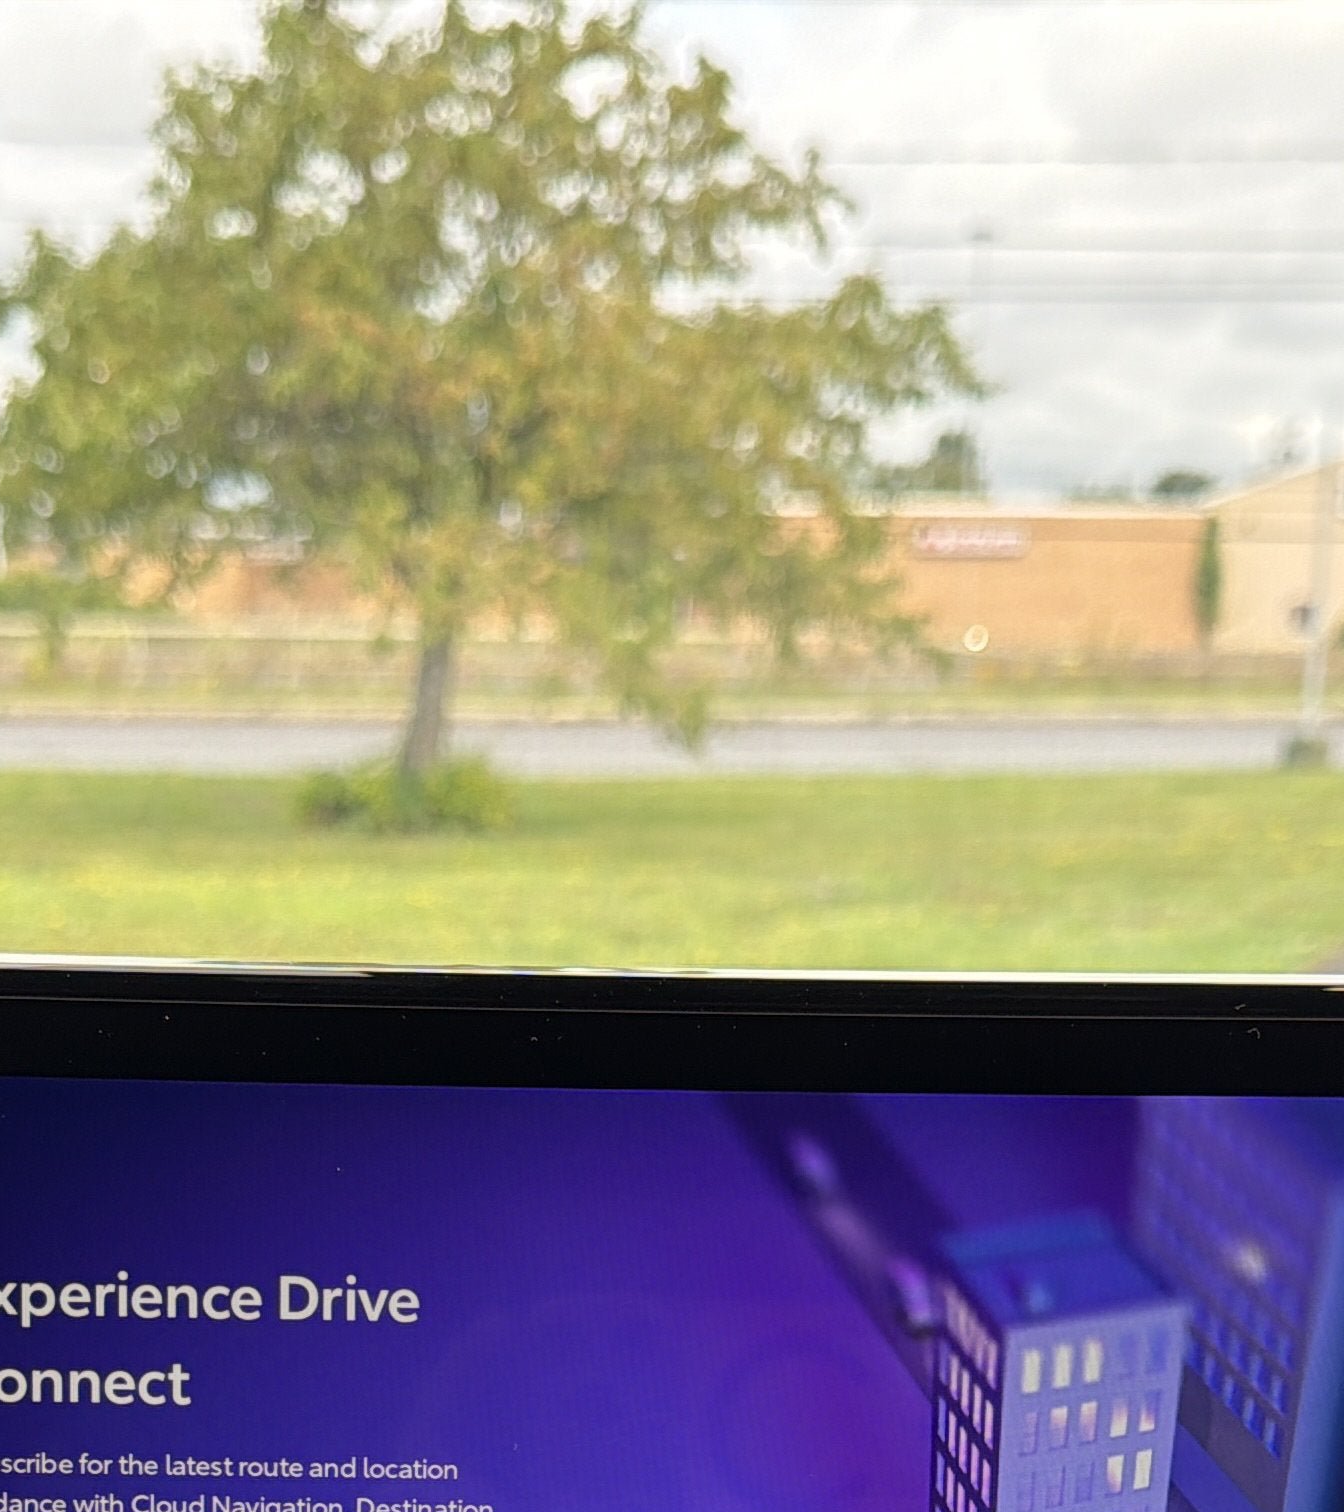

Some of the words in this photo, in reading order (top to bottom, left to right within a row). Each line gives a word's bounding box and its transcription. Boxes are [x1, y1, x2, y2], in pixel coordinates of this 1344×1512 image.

[279, 1275, 420, 1323] Drive
[79, 1452, 112, 1475] for
[118, 1452, 158, 1476] the
[164, 1454, 234, 1477] latest
[238, 1458, 303, 1479] route
[308, 1456, 356, 1480] and
[362, 1456, 458, 1481] location
